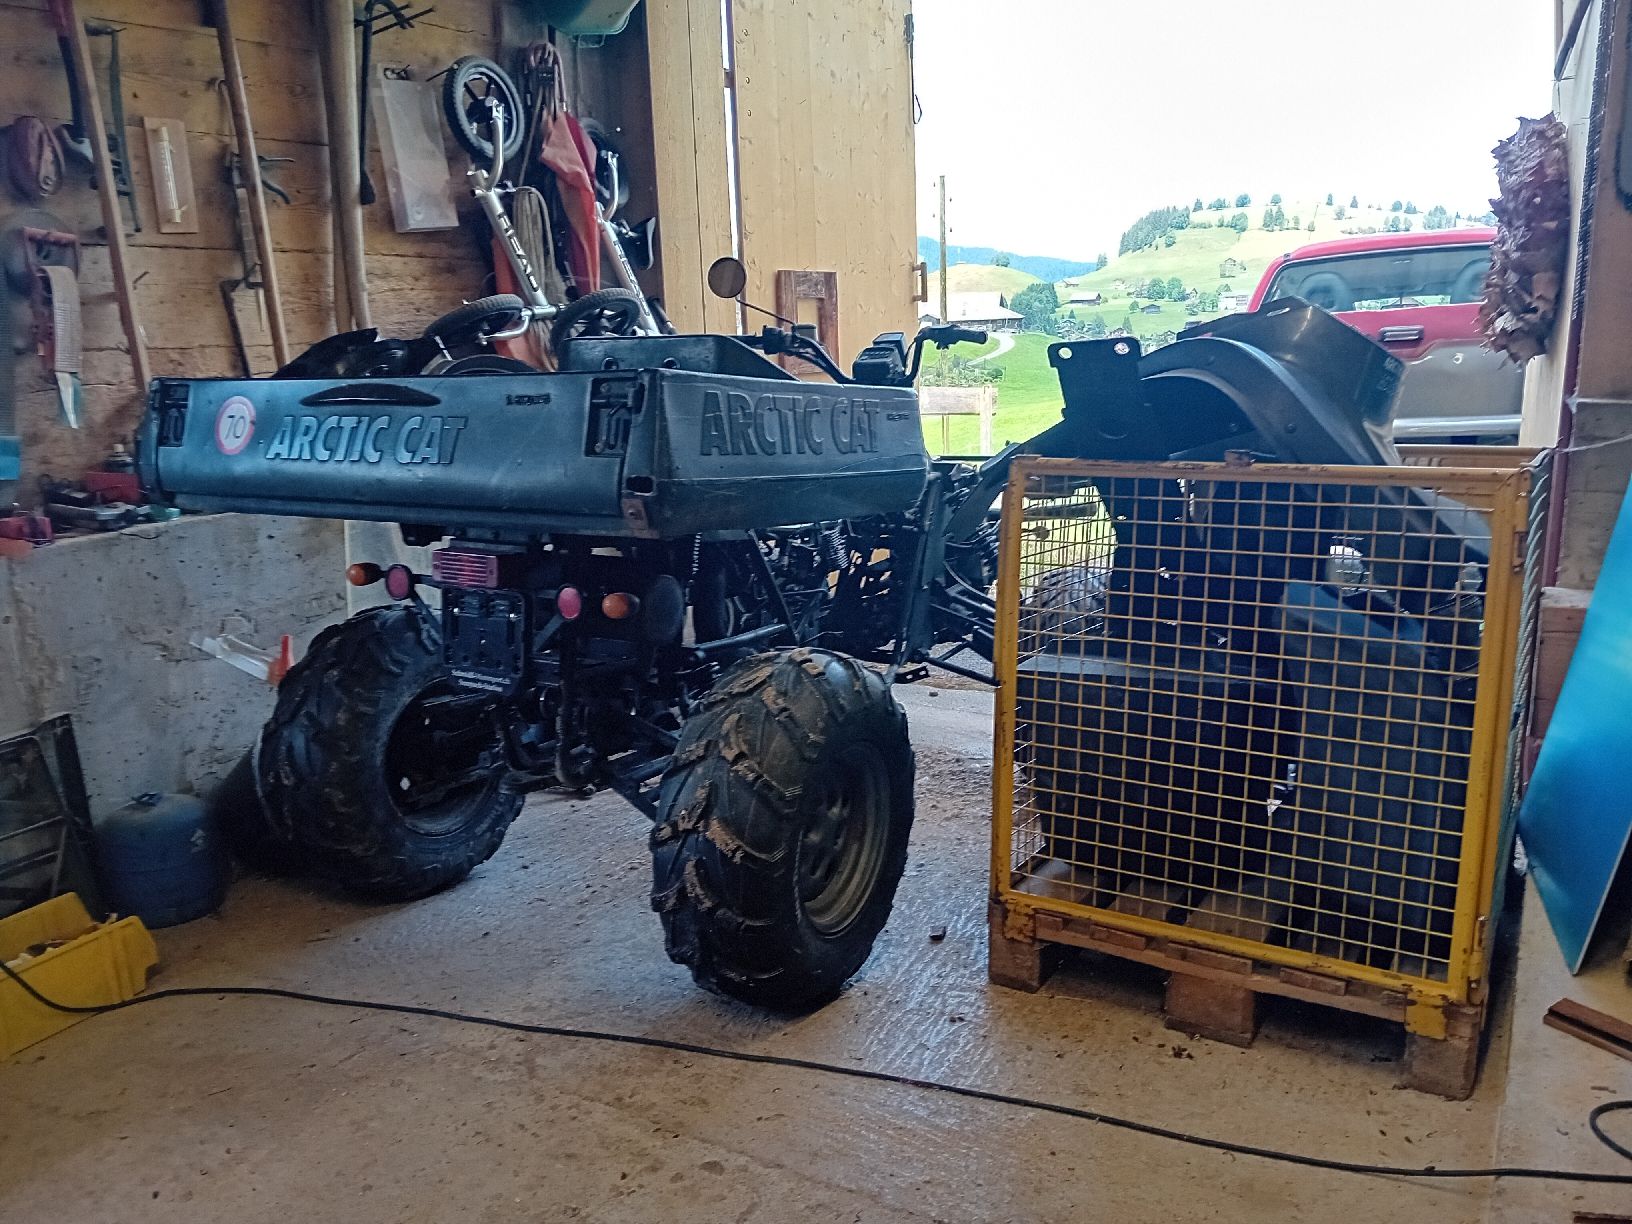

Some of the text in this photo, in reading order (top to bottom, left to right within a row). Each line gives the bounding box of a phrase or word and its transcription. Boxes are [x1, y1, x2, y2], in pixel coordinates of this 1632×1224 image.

[225, 414, 247, 440] 70
[265, 415, 468, 465] ARCTIC CAT
[700, 390, 880, 456] ARCTIC CAT
